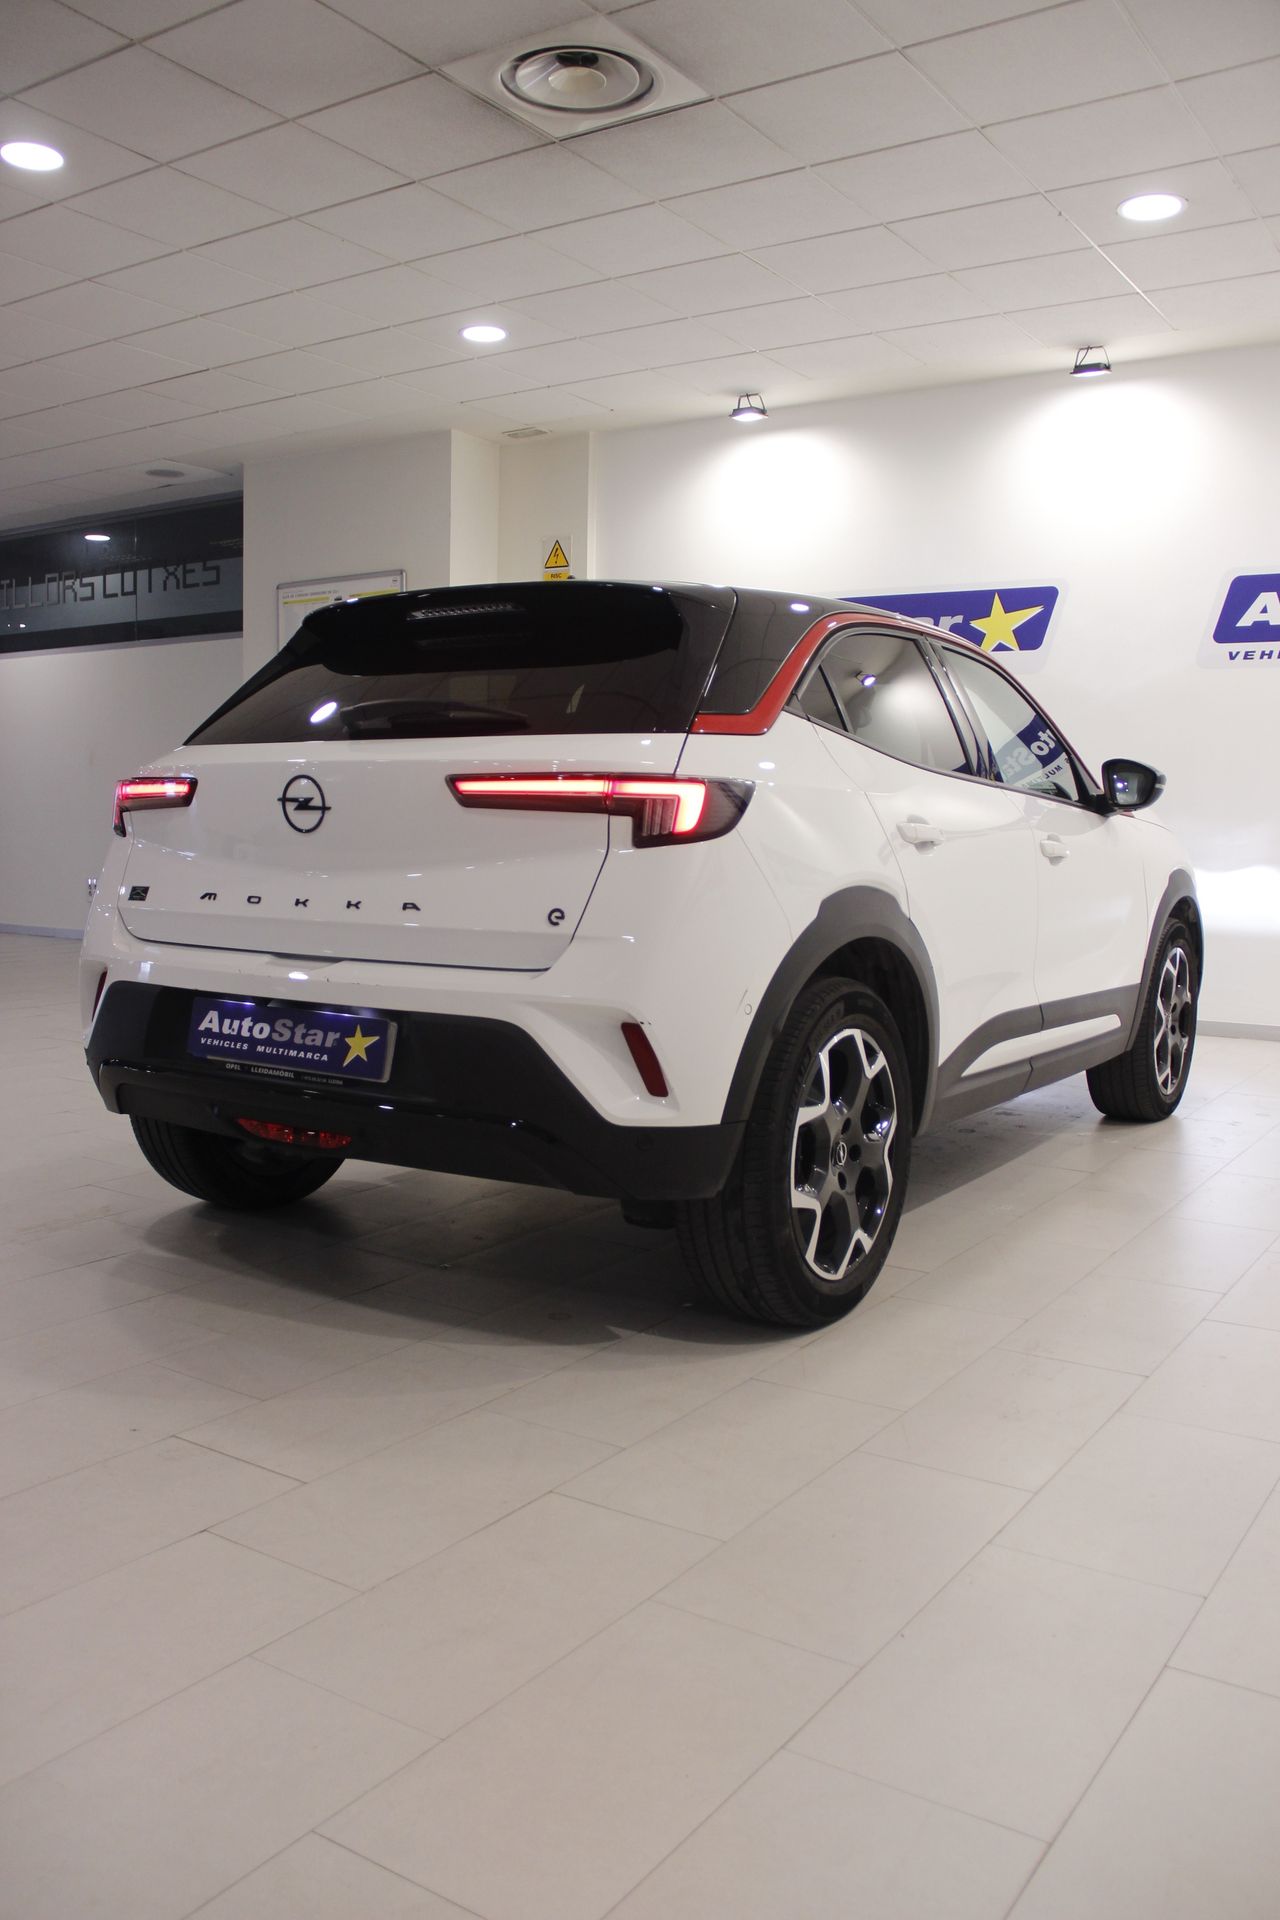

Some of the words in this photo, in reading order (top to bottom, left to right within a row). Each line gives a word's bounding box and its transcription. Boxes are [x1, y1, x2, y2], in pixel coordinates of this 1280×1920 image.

[199, 892, 421, 911] MOKKA
[198, 1010, 340, 1048] AutoStar
[200, 1037, 249, 1050] VEHICLES
[256, 1045, 329, 1061] MULTIMARCA
